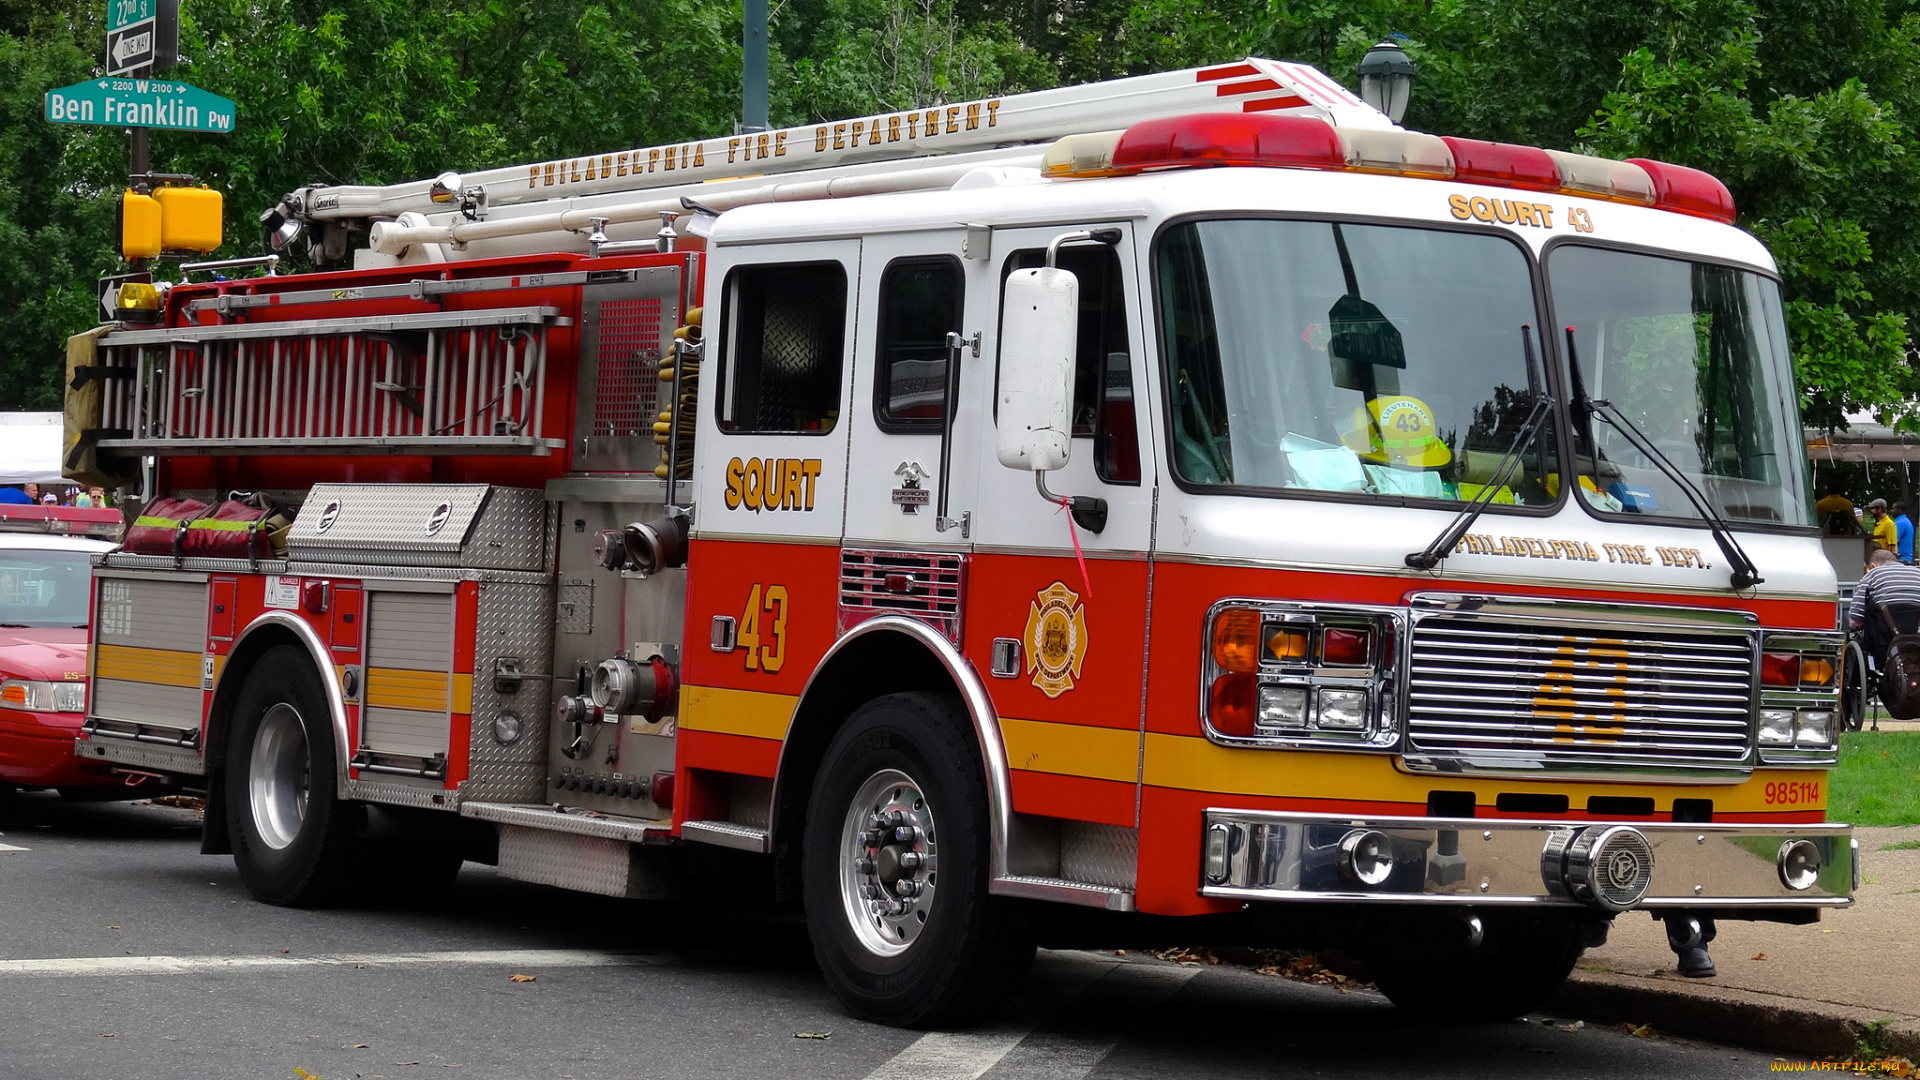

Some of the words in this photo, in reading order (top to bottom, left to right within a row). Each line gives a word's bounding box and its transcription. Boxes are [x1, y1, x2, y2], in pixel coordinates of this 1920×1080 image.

[122, 39, 135, 57] ONE
[135, 34, 149, 54] WAY
[112, 81, 134, 92] 2200
[136, 80, 149, 94] W
[151, 83, 173, 94] 2100
[51, 94, 94, 122] Ben
[104, 96, 199, 128] Franklin
[529, 143, 706, 189] PHILADELPHIA
[727, 130, 788, 164] FIRE
[814, 100, 1001, 153] DEPARTMENT
[1448, 194, 1554, 229] SQURT
[1567, 207, 1595, 234] 43
[1382, 401, 1428, 420] LIEUTENANT
[1396, 413, 1421, 433] 43
[724, 456, 822, 515] SQURT
[1602, 543, 1653, 566] FIRE
[1655, 546, 1713, 570] DEPT.
[103, 582, 132, 603] DIAL
[102, 603, 132, 635] 911
[1040, 600, 1074, 620] PHILADELPHIA
[737, 583, 789, 673] 43
[1043, 654, 1075, 680] DEPARTMENT
[1529, 635, 1630, 744] 43
[1764, 781, 1820, 805] 985114
